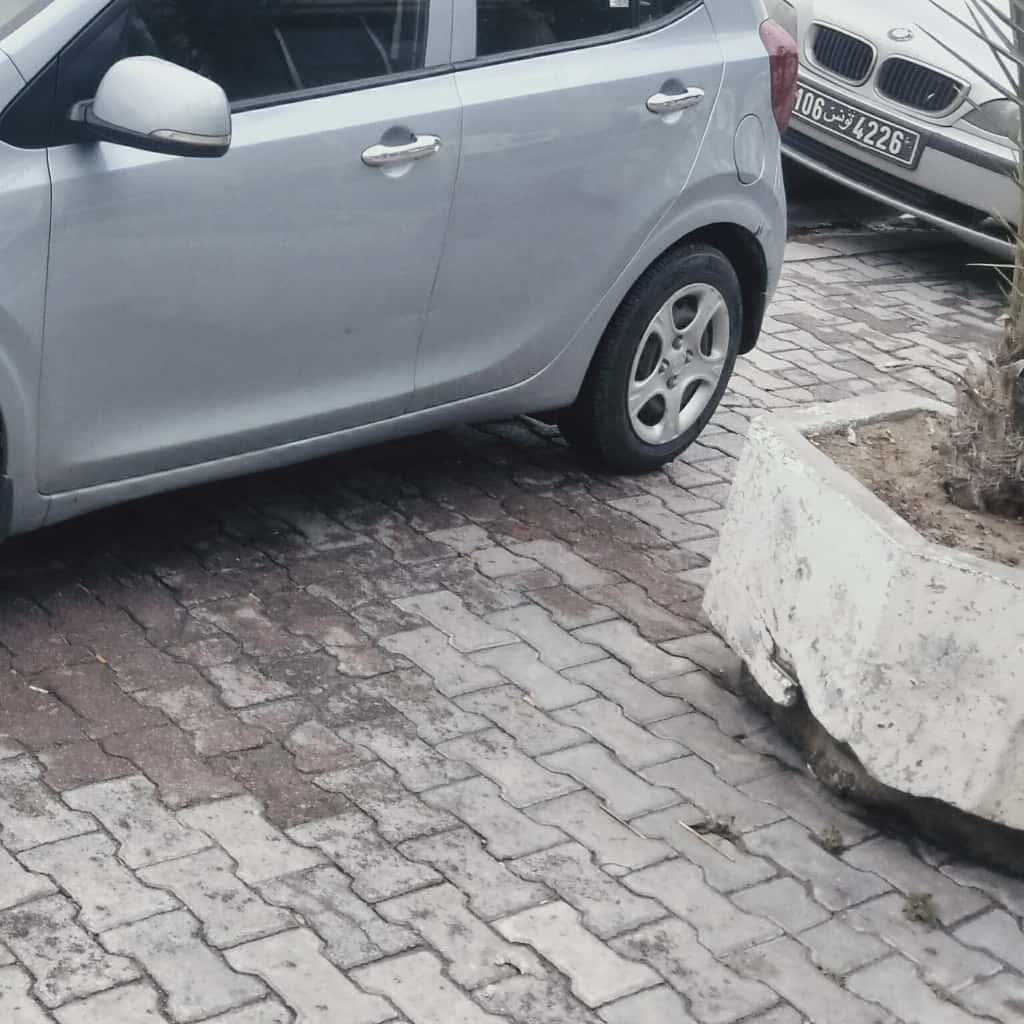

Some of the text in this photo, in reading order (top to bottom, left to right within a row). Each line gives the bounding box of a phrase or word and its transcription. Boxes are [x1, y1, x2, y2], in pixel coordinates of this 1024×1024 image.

[794, 88, 904, 155] 106 تونس 4226
